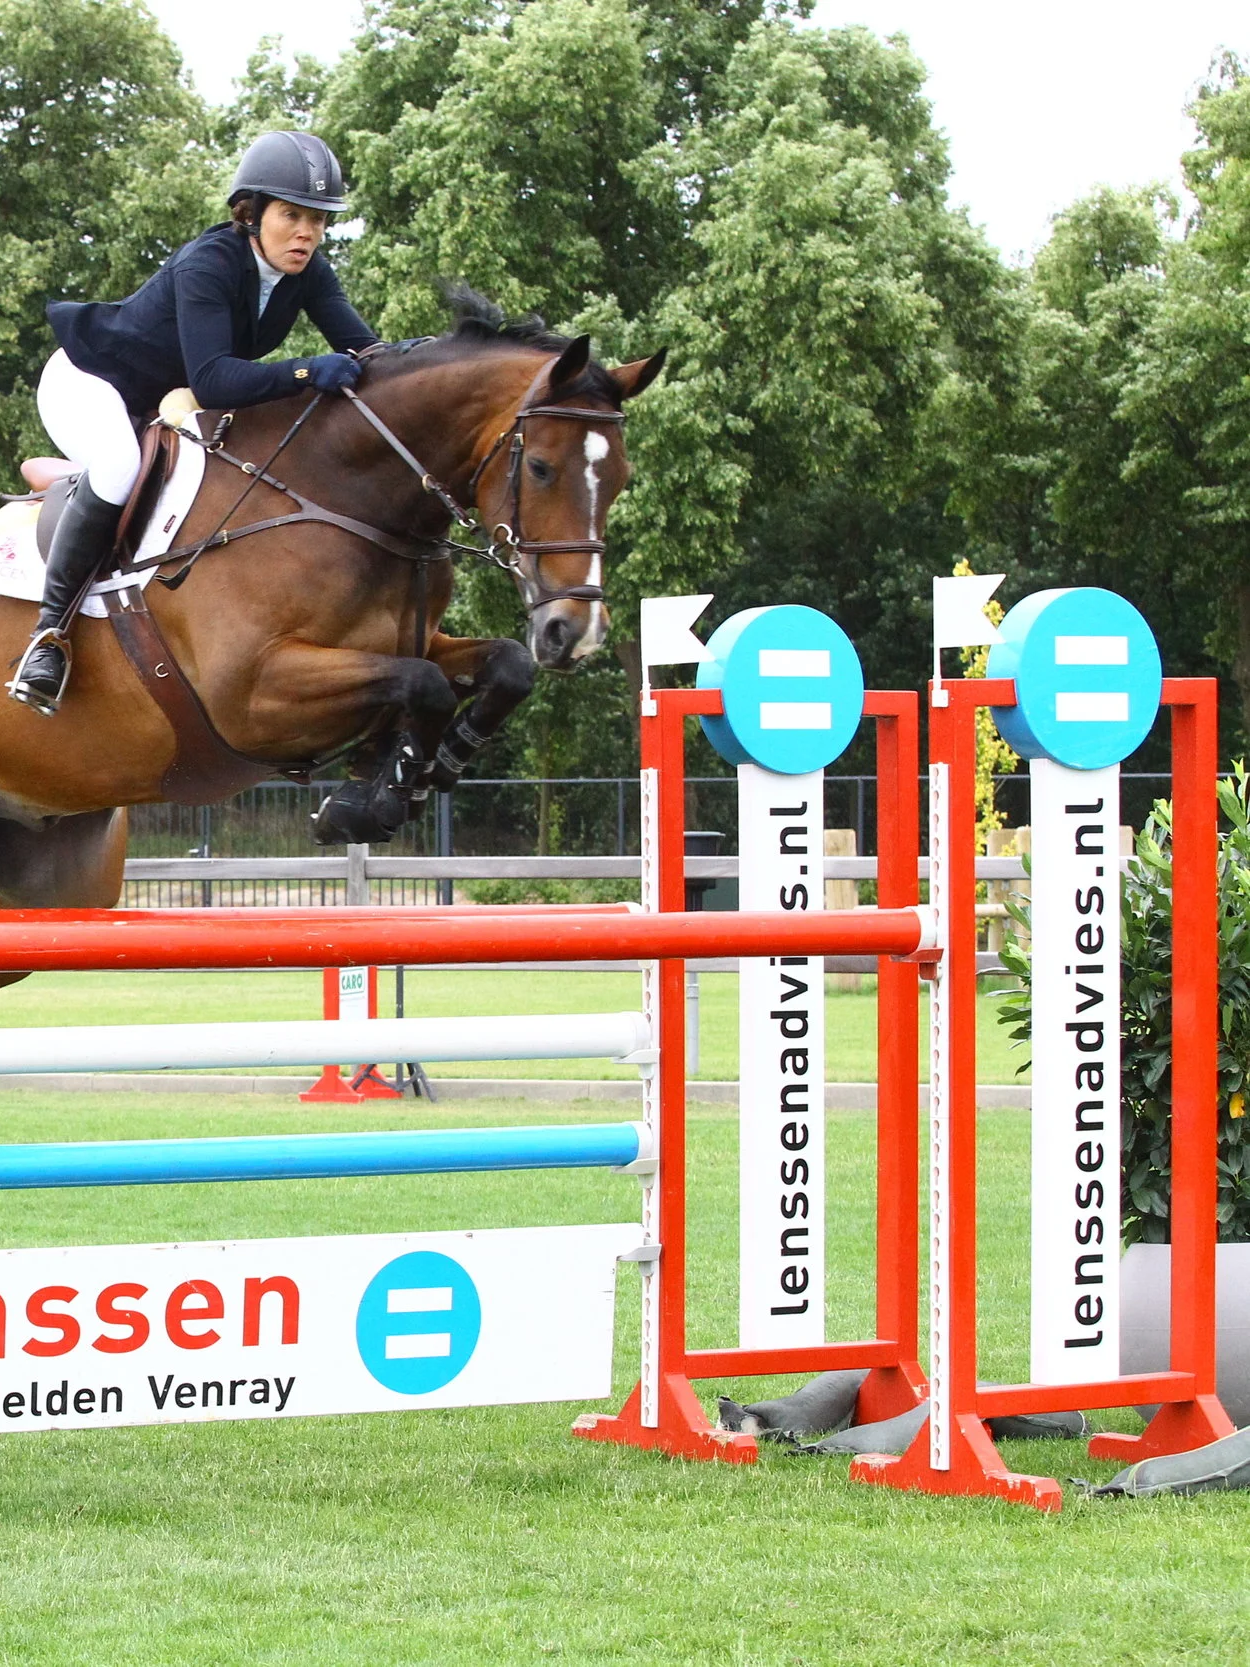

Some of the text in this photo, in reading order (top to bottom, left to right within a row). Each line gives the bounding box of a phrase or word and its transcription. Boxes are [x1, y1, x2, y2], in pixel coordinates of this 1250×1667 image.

[769, 801, 809, 1316] lenssenadvis.nl
[1064, 798, 1104, 1348] lenssenadvies.nl
[147, 1374, 296, 1417] Venray
